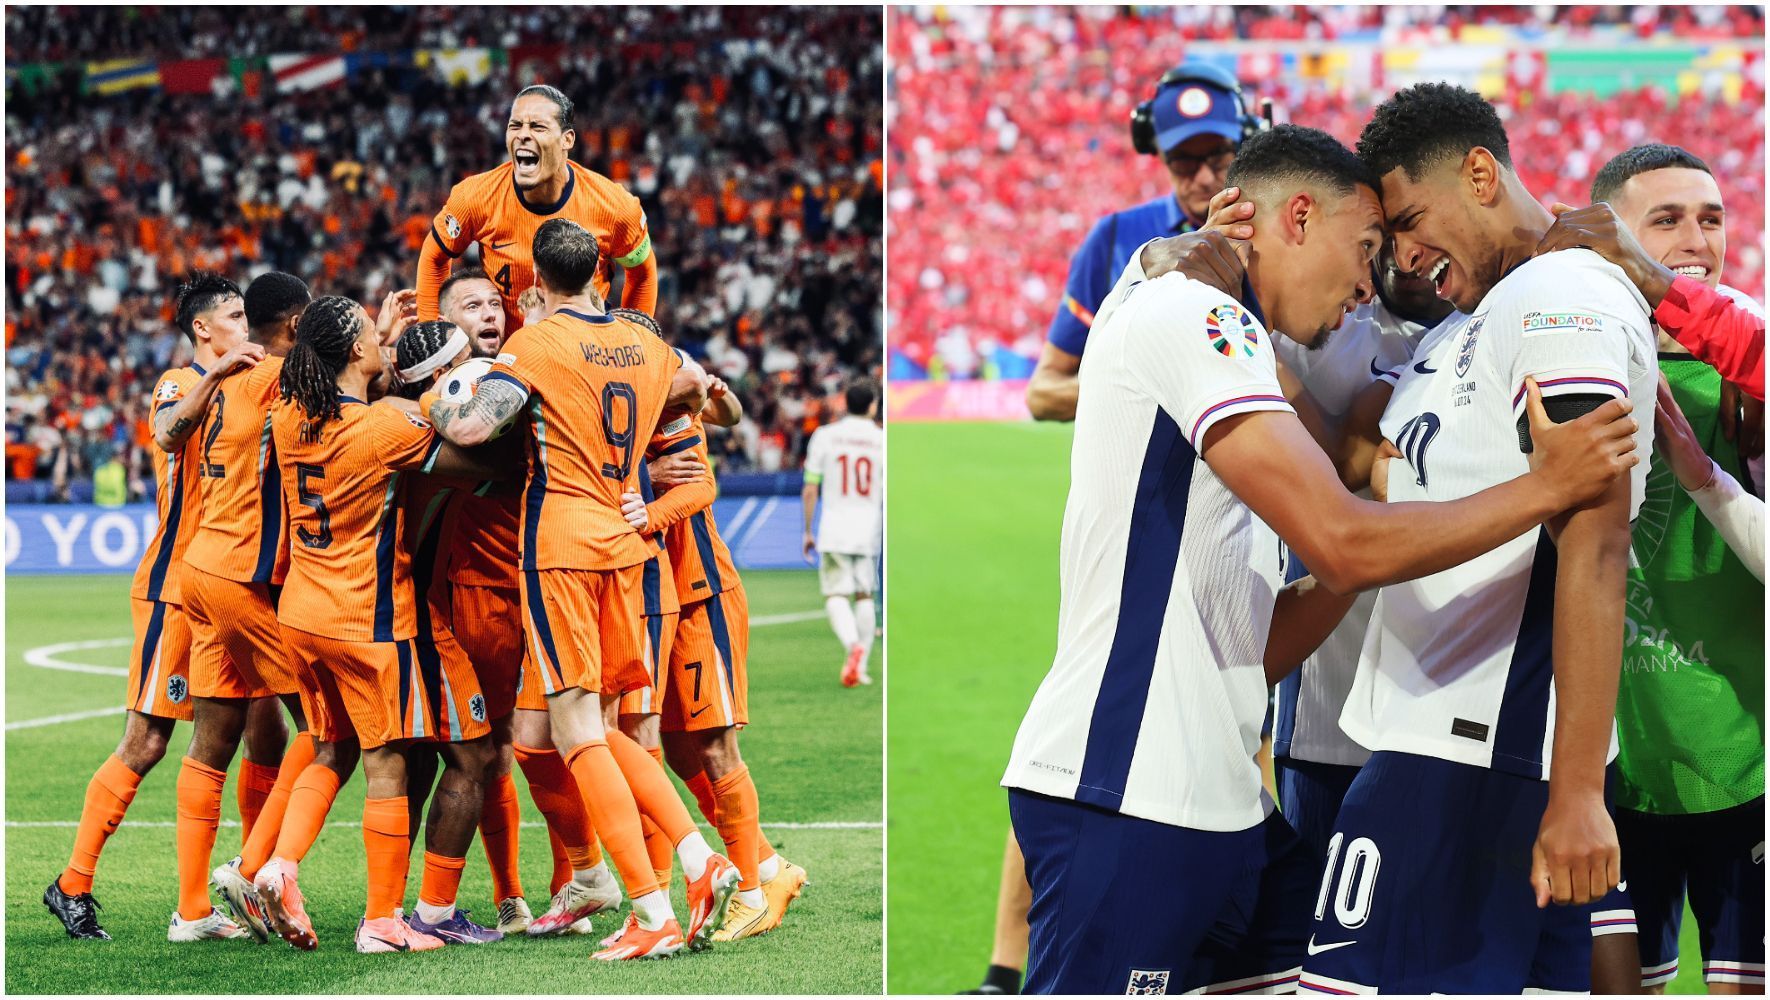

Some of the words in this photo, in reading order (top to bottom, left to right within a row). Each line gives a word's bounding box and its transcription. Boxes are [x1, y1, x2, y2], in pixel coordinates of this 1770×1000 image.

[495, 263, 512, 296] 4
[580, 341, 645, 368] WEGHORST
[601, 381, 636, 483] 9
[836, 454, 872, 497] 10
[296, 461, 333, 550] 5
[684, 660, 702, 702] 7
[1314, 831, 1382, 930] 10
